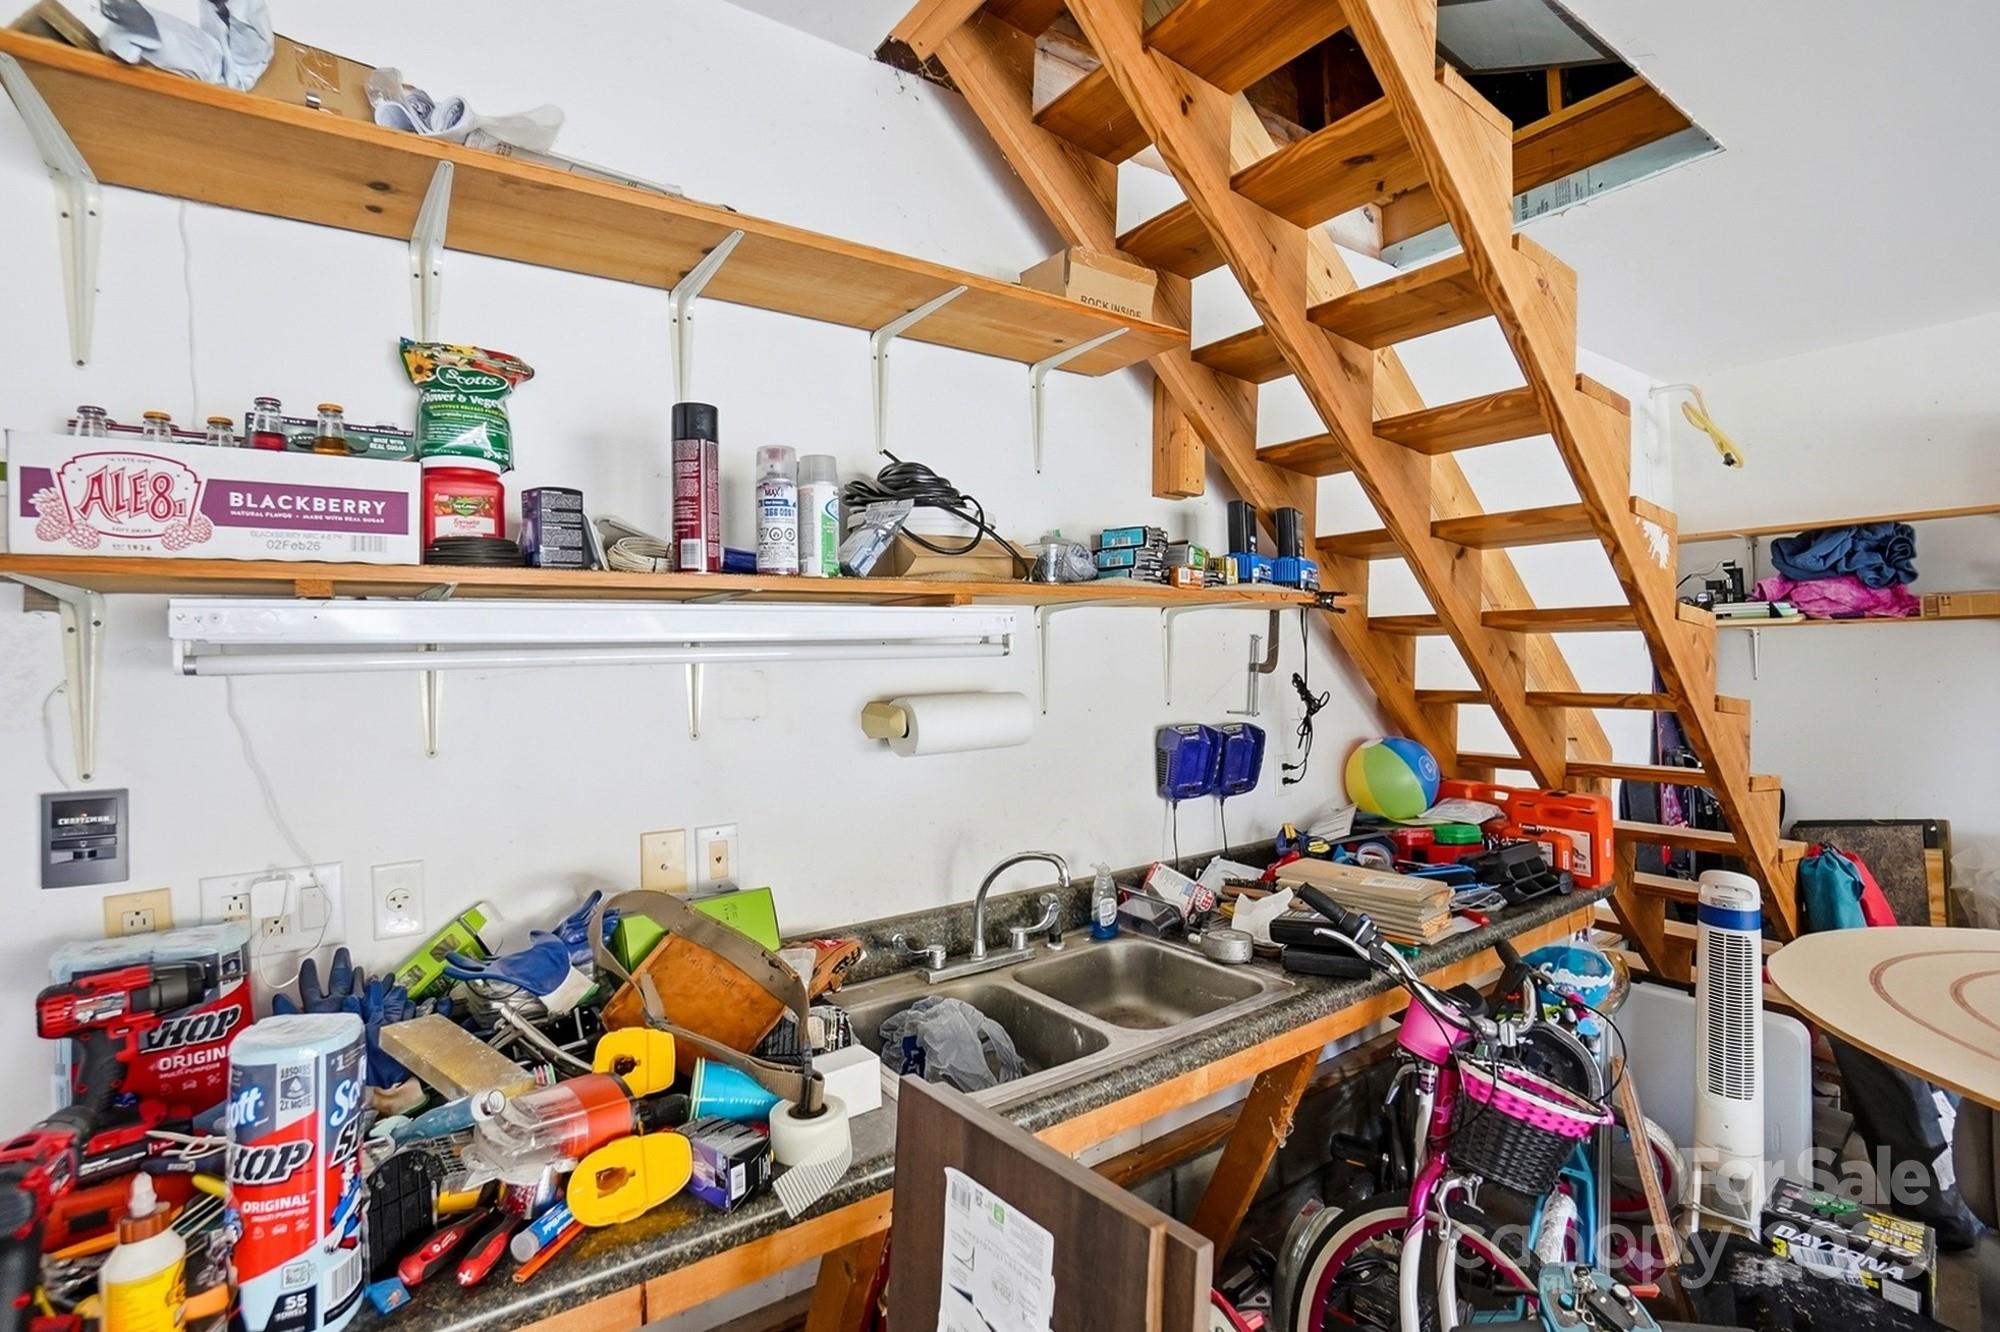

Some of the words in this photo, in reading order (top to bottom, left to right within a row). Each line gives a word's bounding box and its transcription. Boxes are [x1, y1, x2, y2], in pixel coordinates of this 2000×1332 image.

[229, 491, 387, 515] BLACKBERRY
[230, 510, 264, 518] NATURAL
[265, 511, 292, 519] FLAVOR
[266, 539, 321, 551] 02Feb26
[243, 1193, 311, 1214] ORIGINAL
